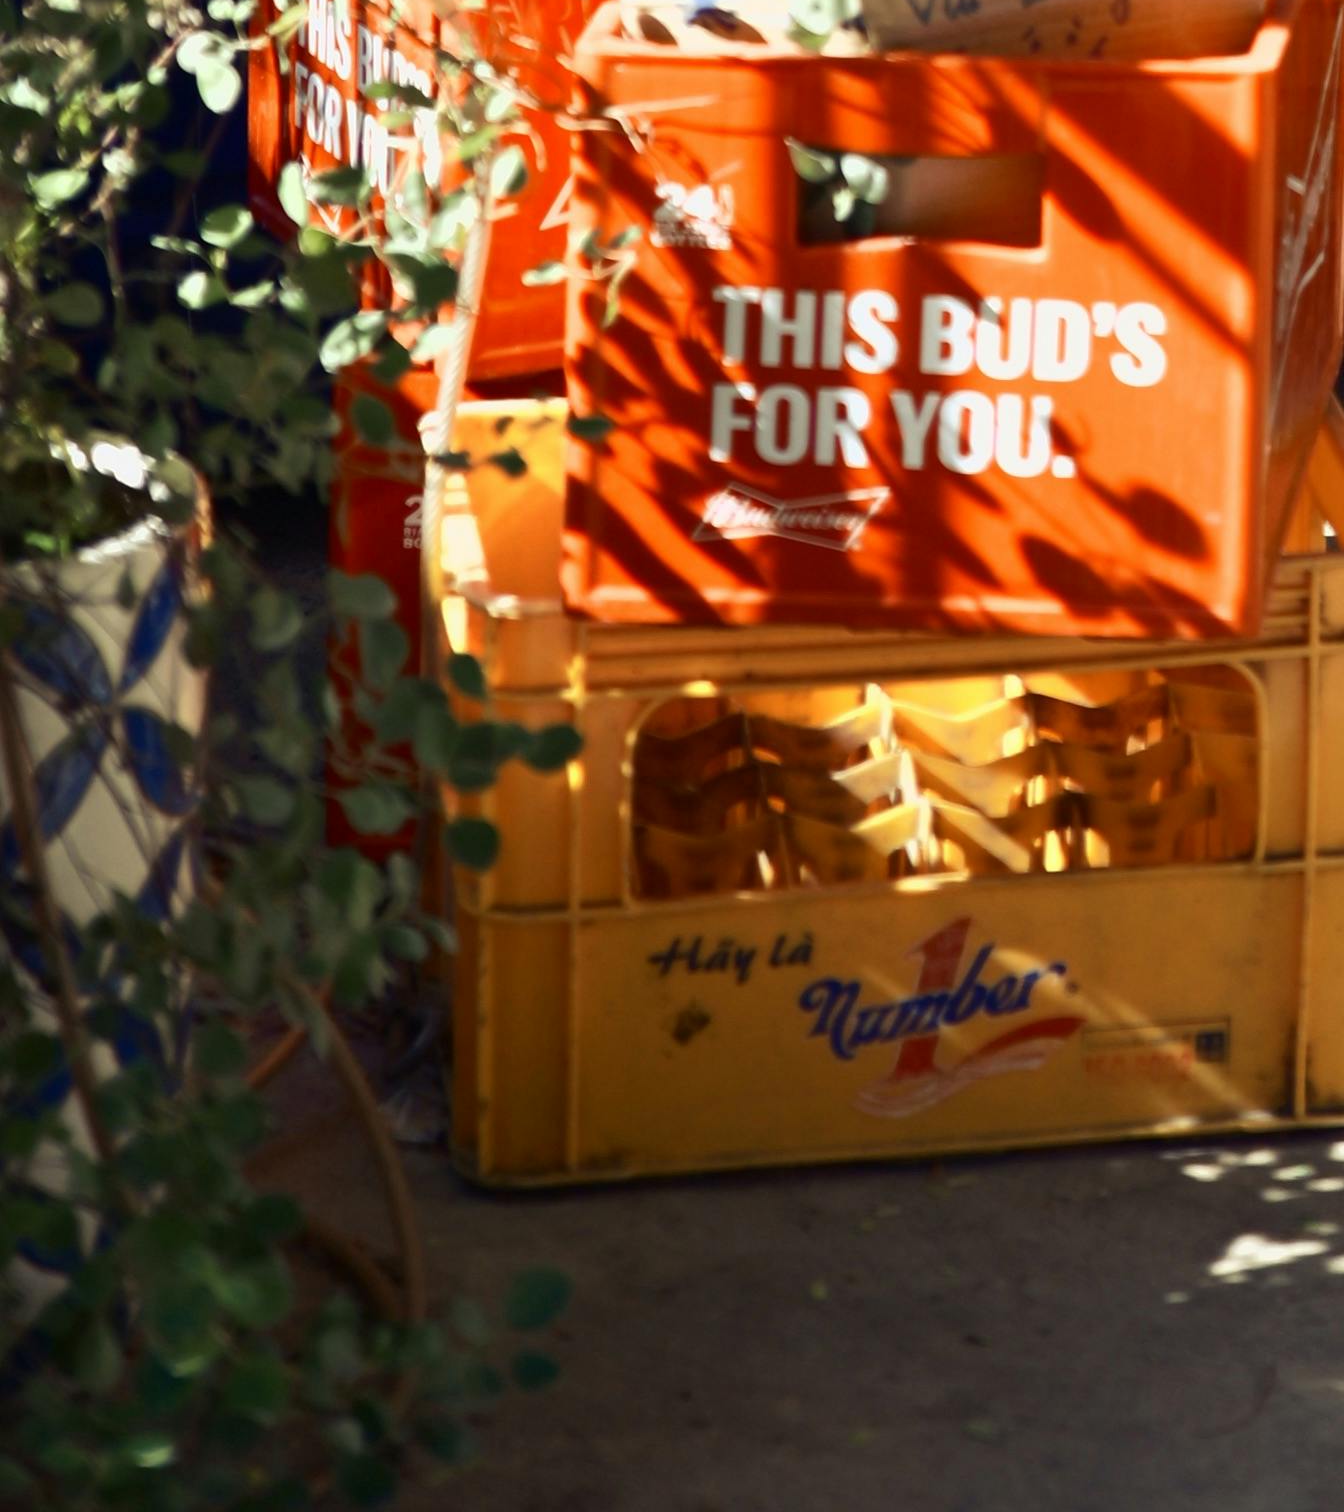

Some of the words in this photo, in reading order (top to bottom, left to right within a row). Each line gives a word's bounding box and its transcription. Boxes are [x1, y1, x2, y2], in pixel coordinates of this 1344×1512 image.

[711, 284, 899, 375] THIS
[919, 289, 1169, 391] BUD'S
[708, 381, 872, 469] FOR
[888, 389, 1078, 480] YOU.
[799, 941, 1068, 1061] Number
